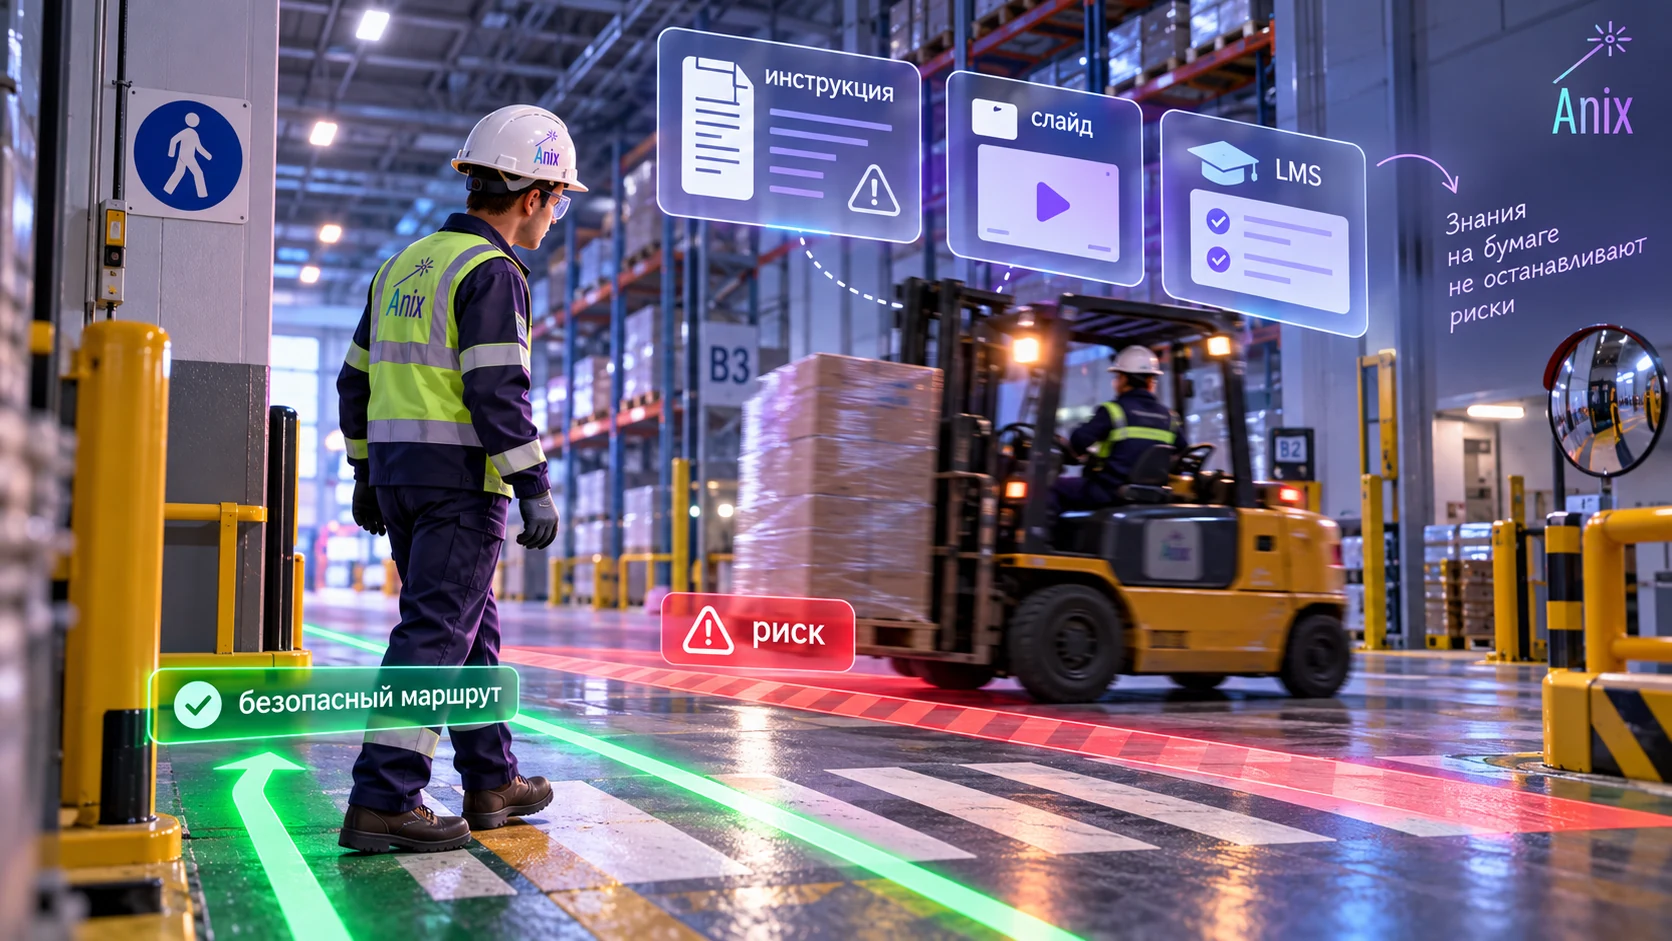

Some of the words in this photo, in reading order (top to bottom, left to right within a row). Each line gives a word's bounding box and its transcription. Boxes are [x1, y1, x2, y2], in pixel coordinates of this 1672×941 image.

[533, 146, 560, 167] Anix
[386, 288, 425, 319] Anix
[710, 345, 749, 384] B3
[1280, 440, 1301, 457] B2
